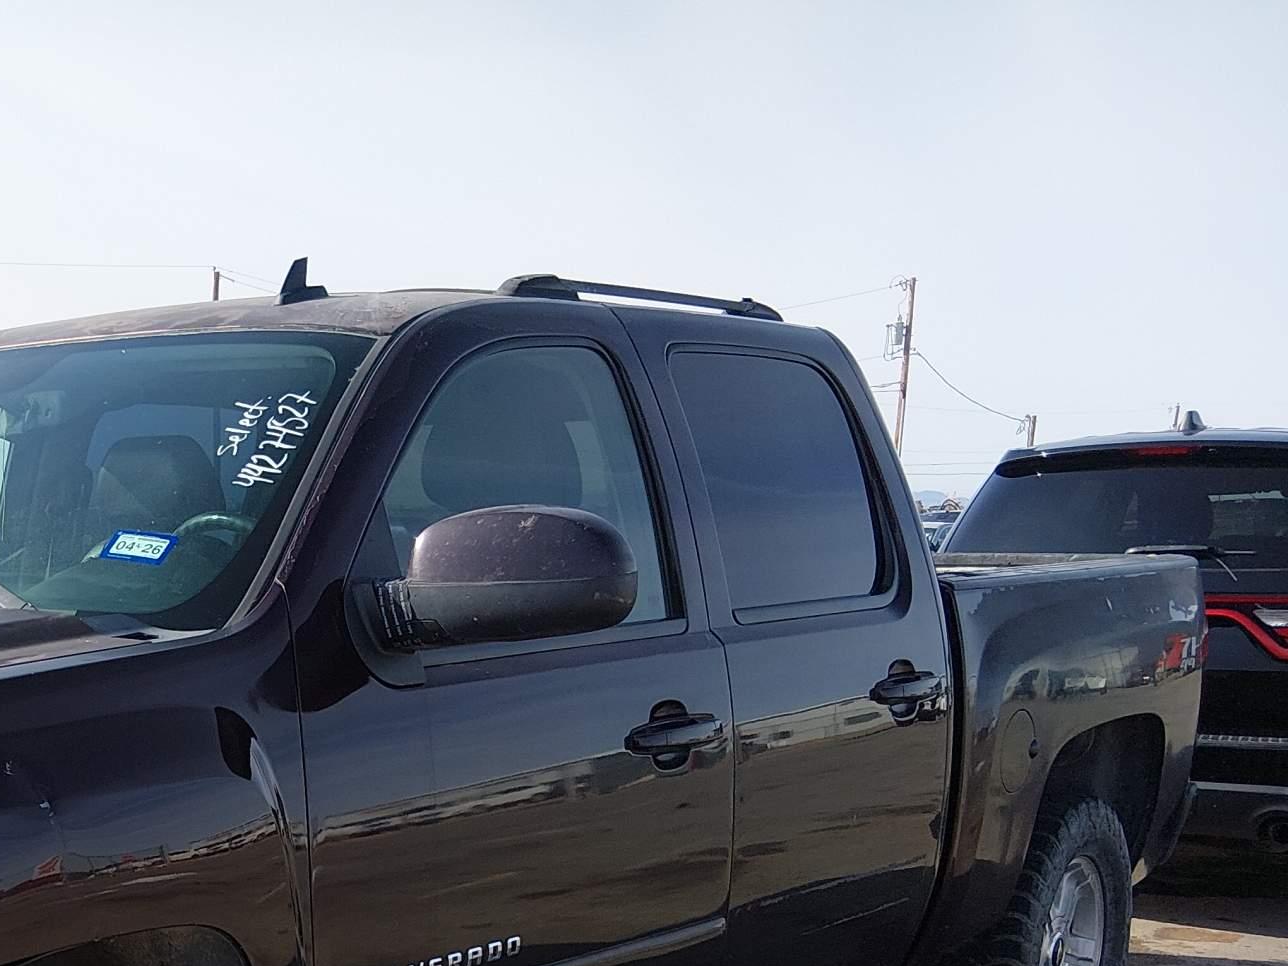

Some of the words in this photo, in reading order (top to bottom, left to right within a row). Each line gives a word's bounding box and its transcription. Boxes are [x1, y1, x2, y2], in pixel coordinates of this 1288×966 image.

[232, 391, 317, 487] 44274527
[115, 540, 136, 552] 04
[141, 543, 163, 555] 26
